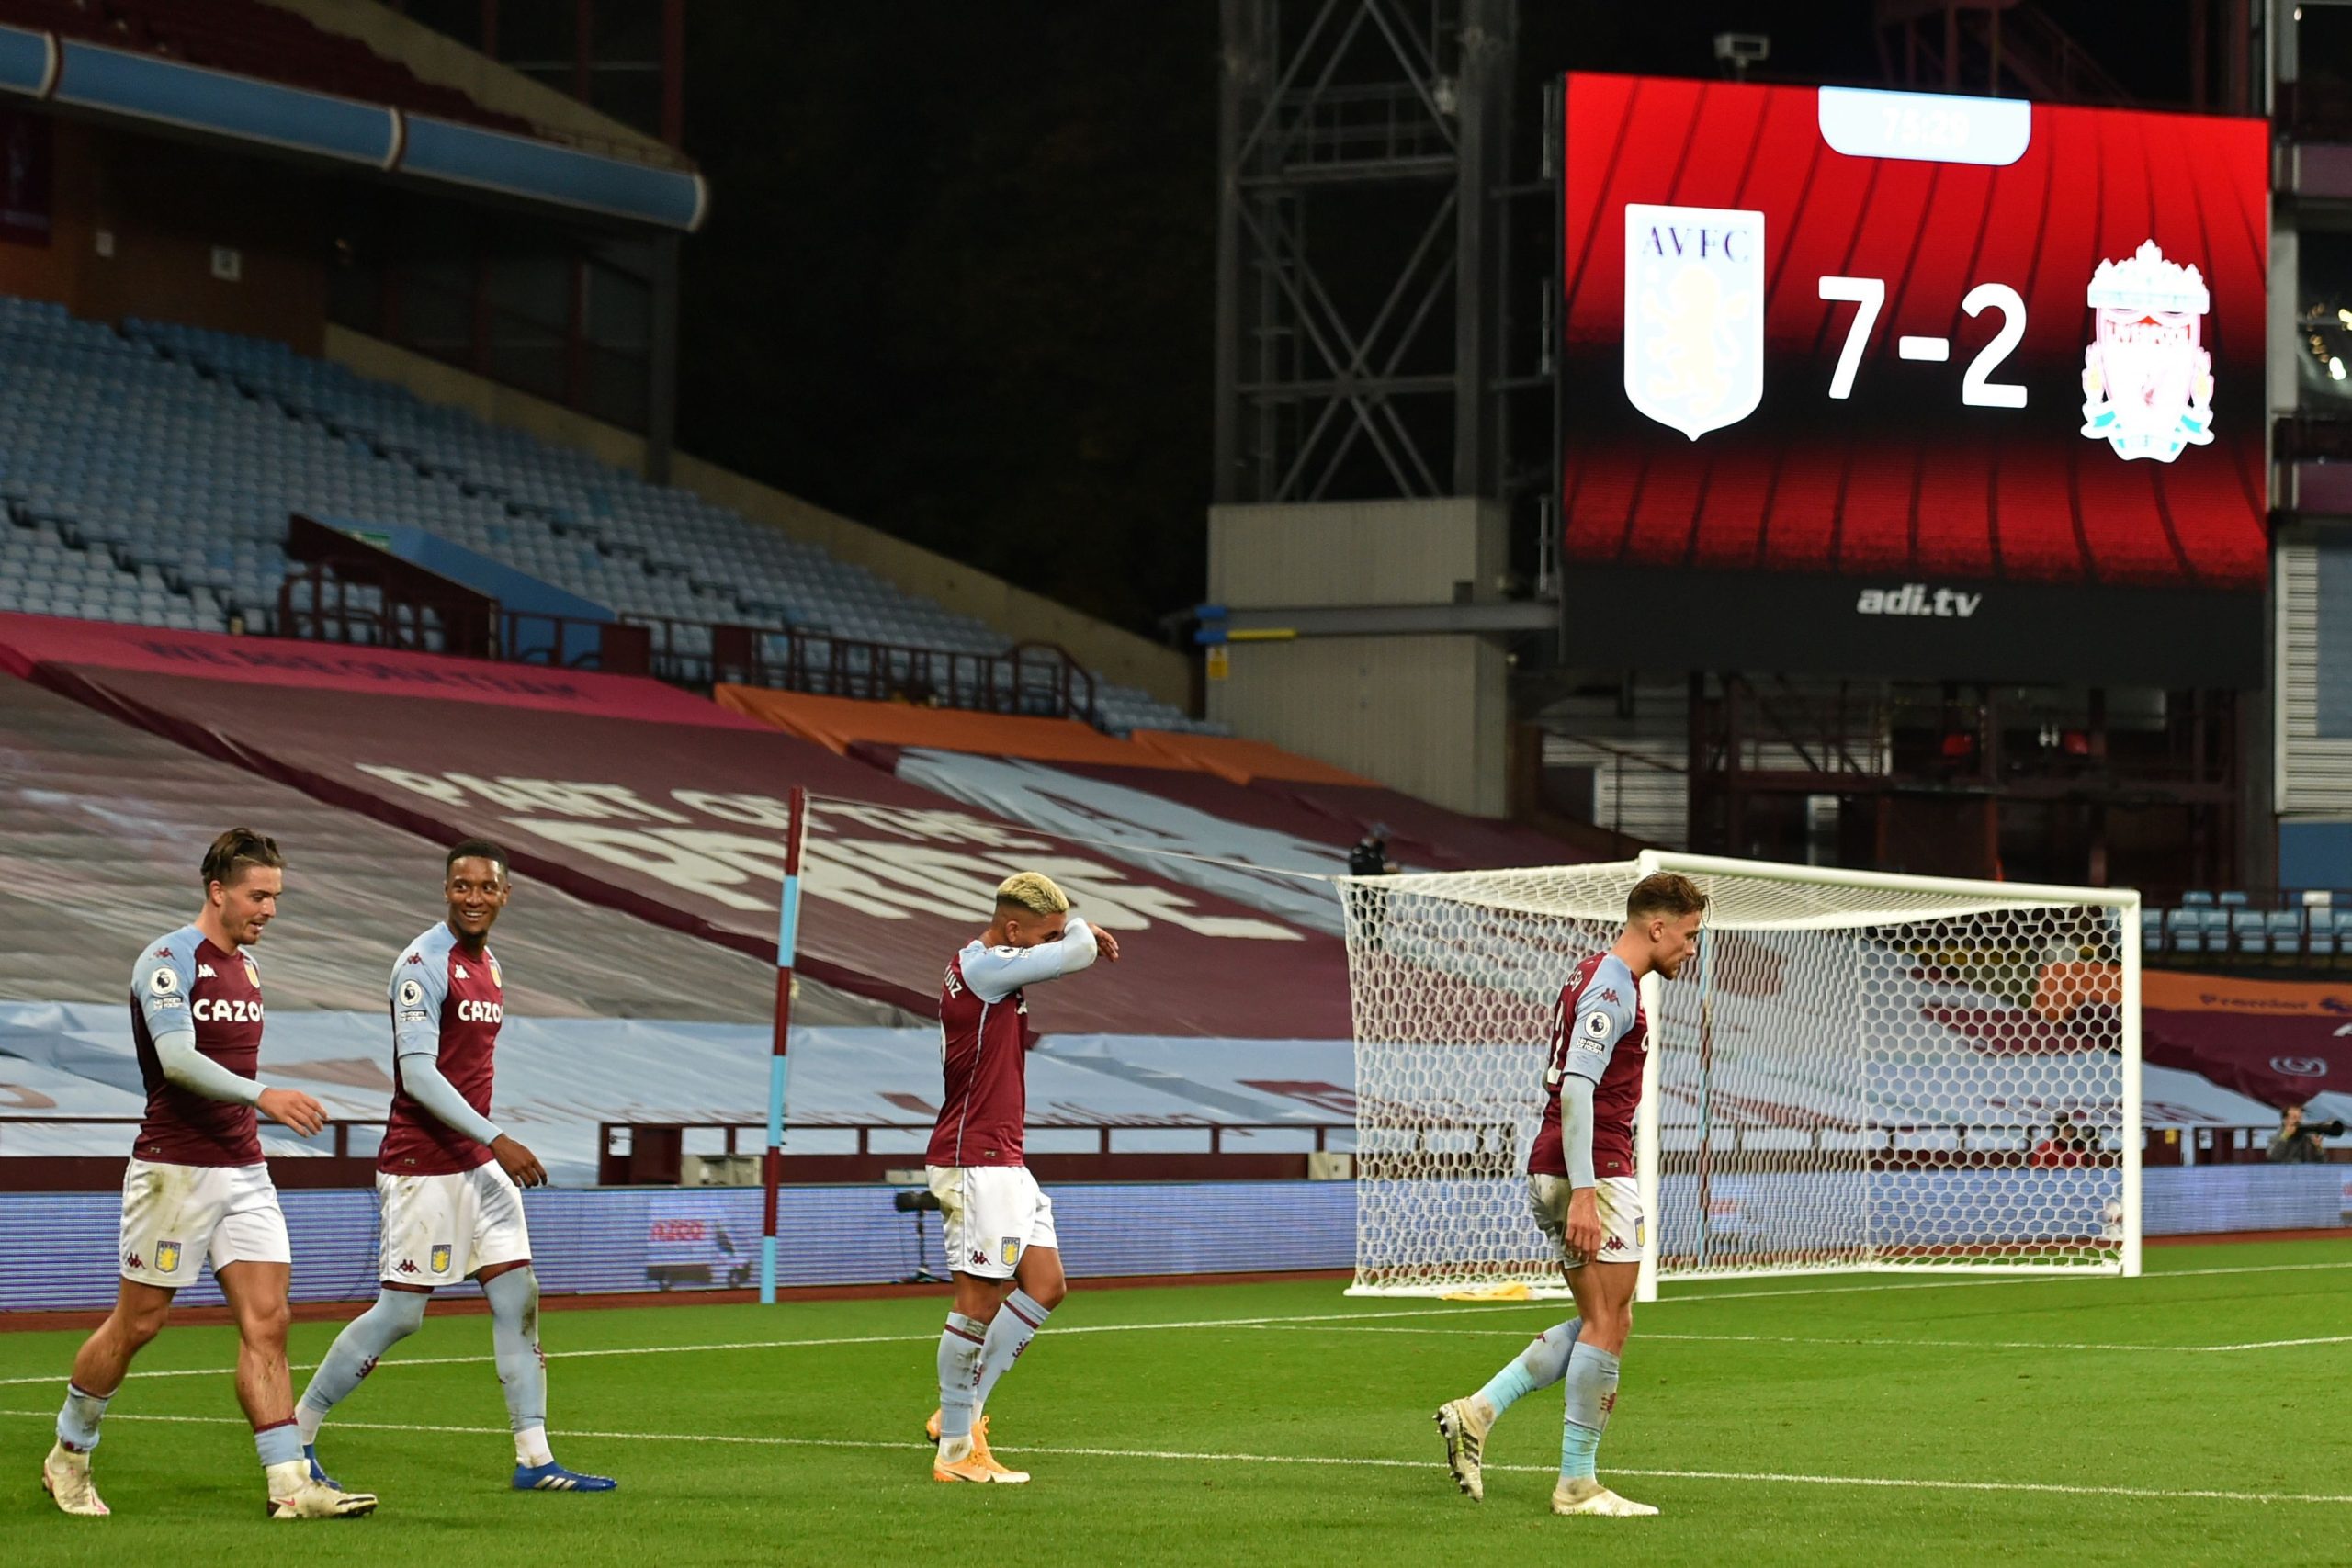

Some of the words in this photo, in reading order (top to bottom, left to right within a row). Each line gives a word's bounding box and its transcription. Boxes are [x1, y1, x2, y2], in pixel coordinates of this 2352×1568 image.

[1642, 225, 1749, 264] AVFC
[1856, 582, 1983, 618] adi.tv
[355, 761, 695, 825] PART
[192, 998, 264, 1022] CAZO
[458, 999, 503, 1023] CAZO
